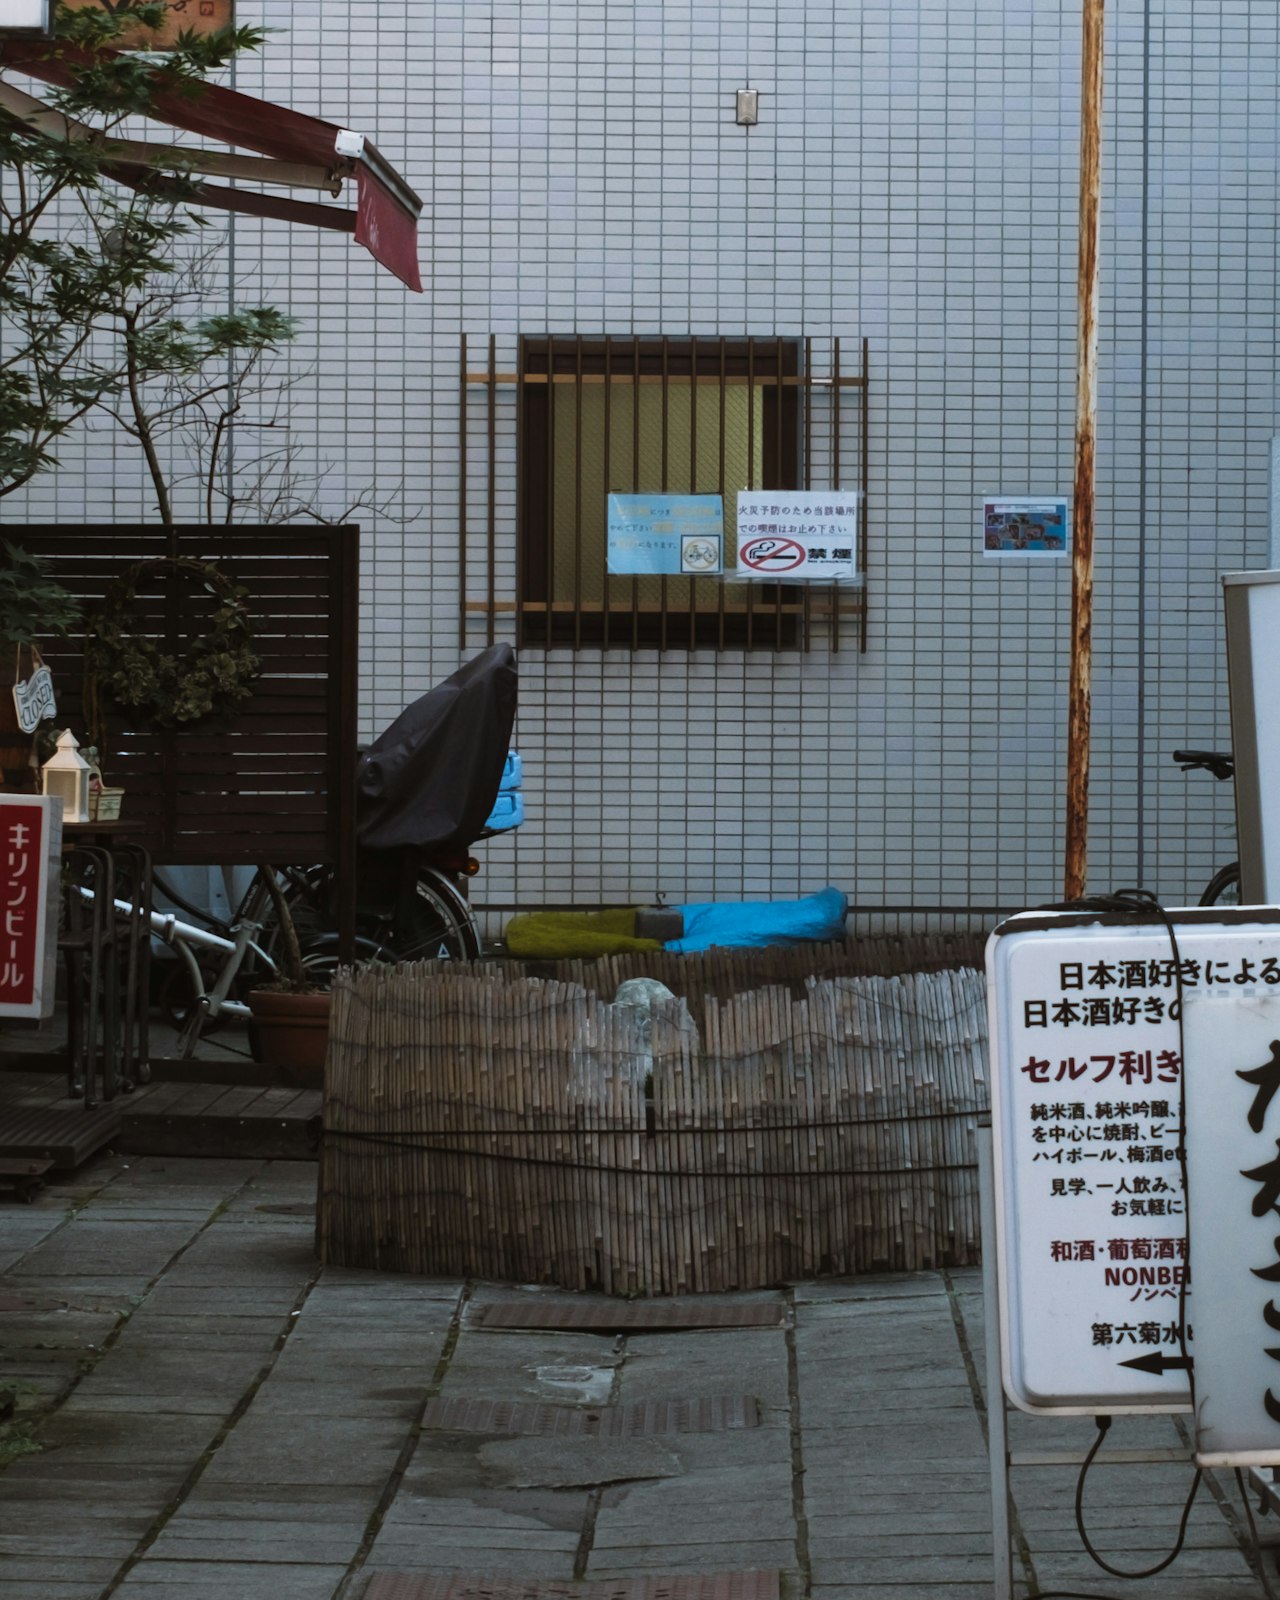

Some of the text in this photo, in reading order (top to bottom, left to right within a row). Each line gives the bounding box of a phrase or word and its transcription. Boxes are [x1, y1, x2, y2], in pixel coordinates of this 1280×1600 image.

[738, 505, 855, 516] 火災予防のため当該場所
[738, 523, 847, 535] での喫煙はお止め下さい
[808, 548, 852, 560] 禁煙
[0, 822, 30, 988] キリンビール
[1021, 1049, 1183, 1086] セルフ利き
[1030, 1100, 1183, 1121] 純米酒、純米吟醸、
[1032, 1122, 1186, 1143] を中心に焼酎、ビー
[1050, 1176, 1185, 1197] 見学、一人飲み、
[1111, 1198, 1187, 1217] お気軽に
